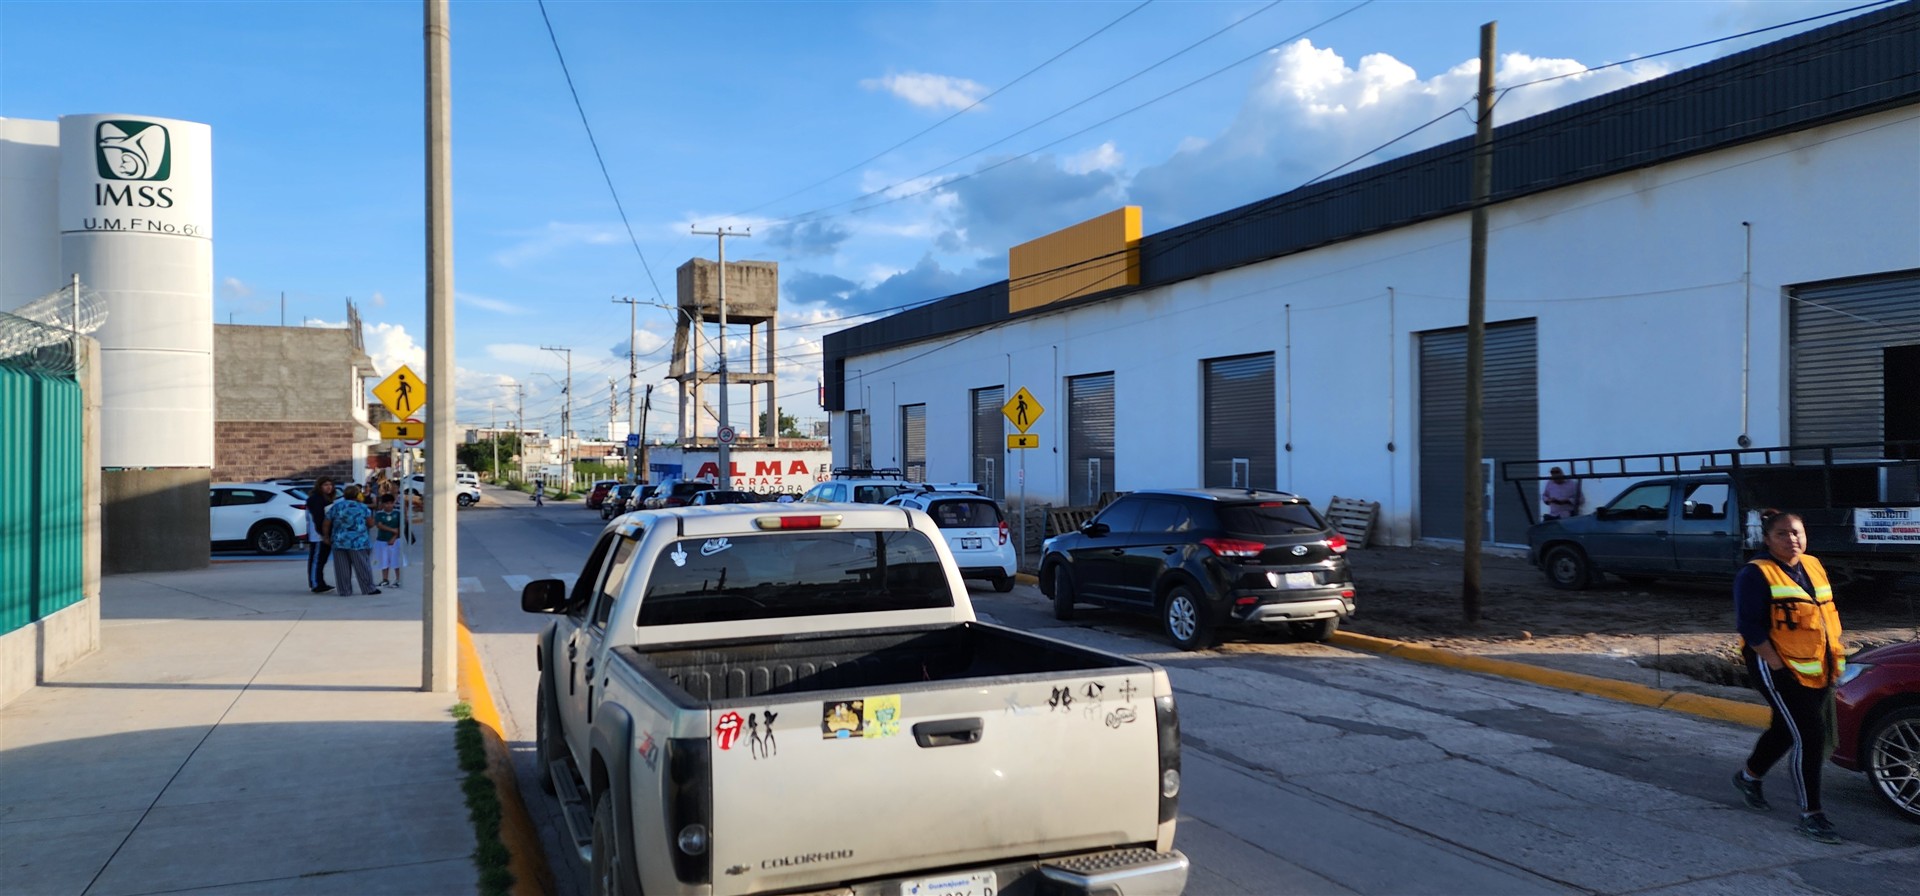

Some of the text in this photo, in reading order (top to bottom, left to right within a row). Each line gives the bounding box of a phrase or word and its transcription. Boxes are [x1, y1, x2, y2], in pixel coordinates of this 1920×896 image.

[96, 183, 173, 208] IMSS
[696, 460, 809, 478] ALMA
[761, 850, 853, 869] COLORADO
